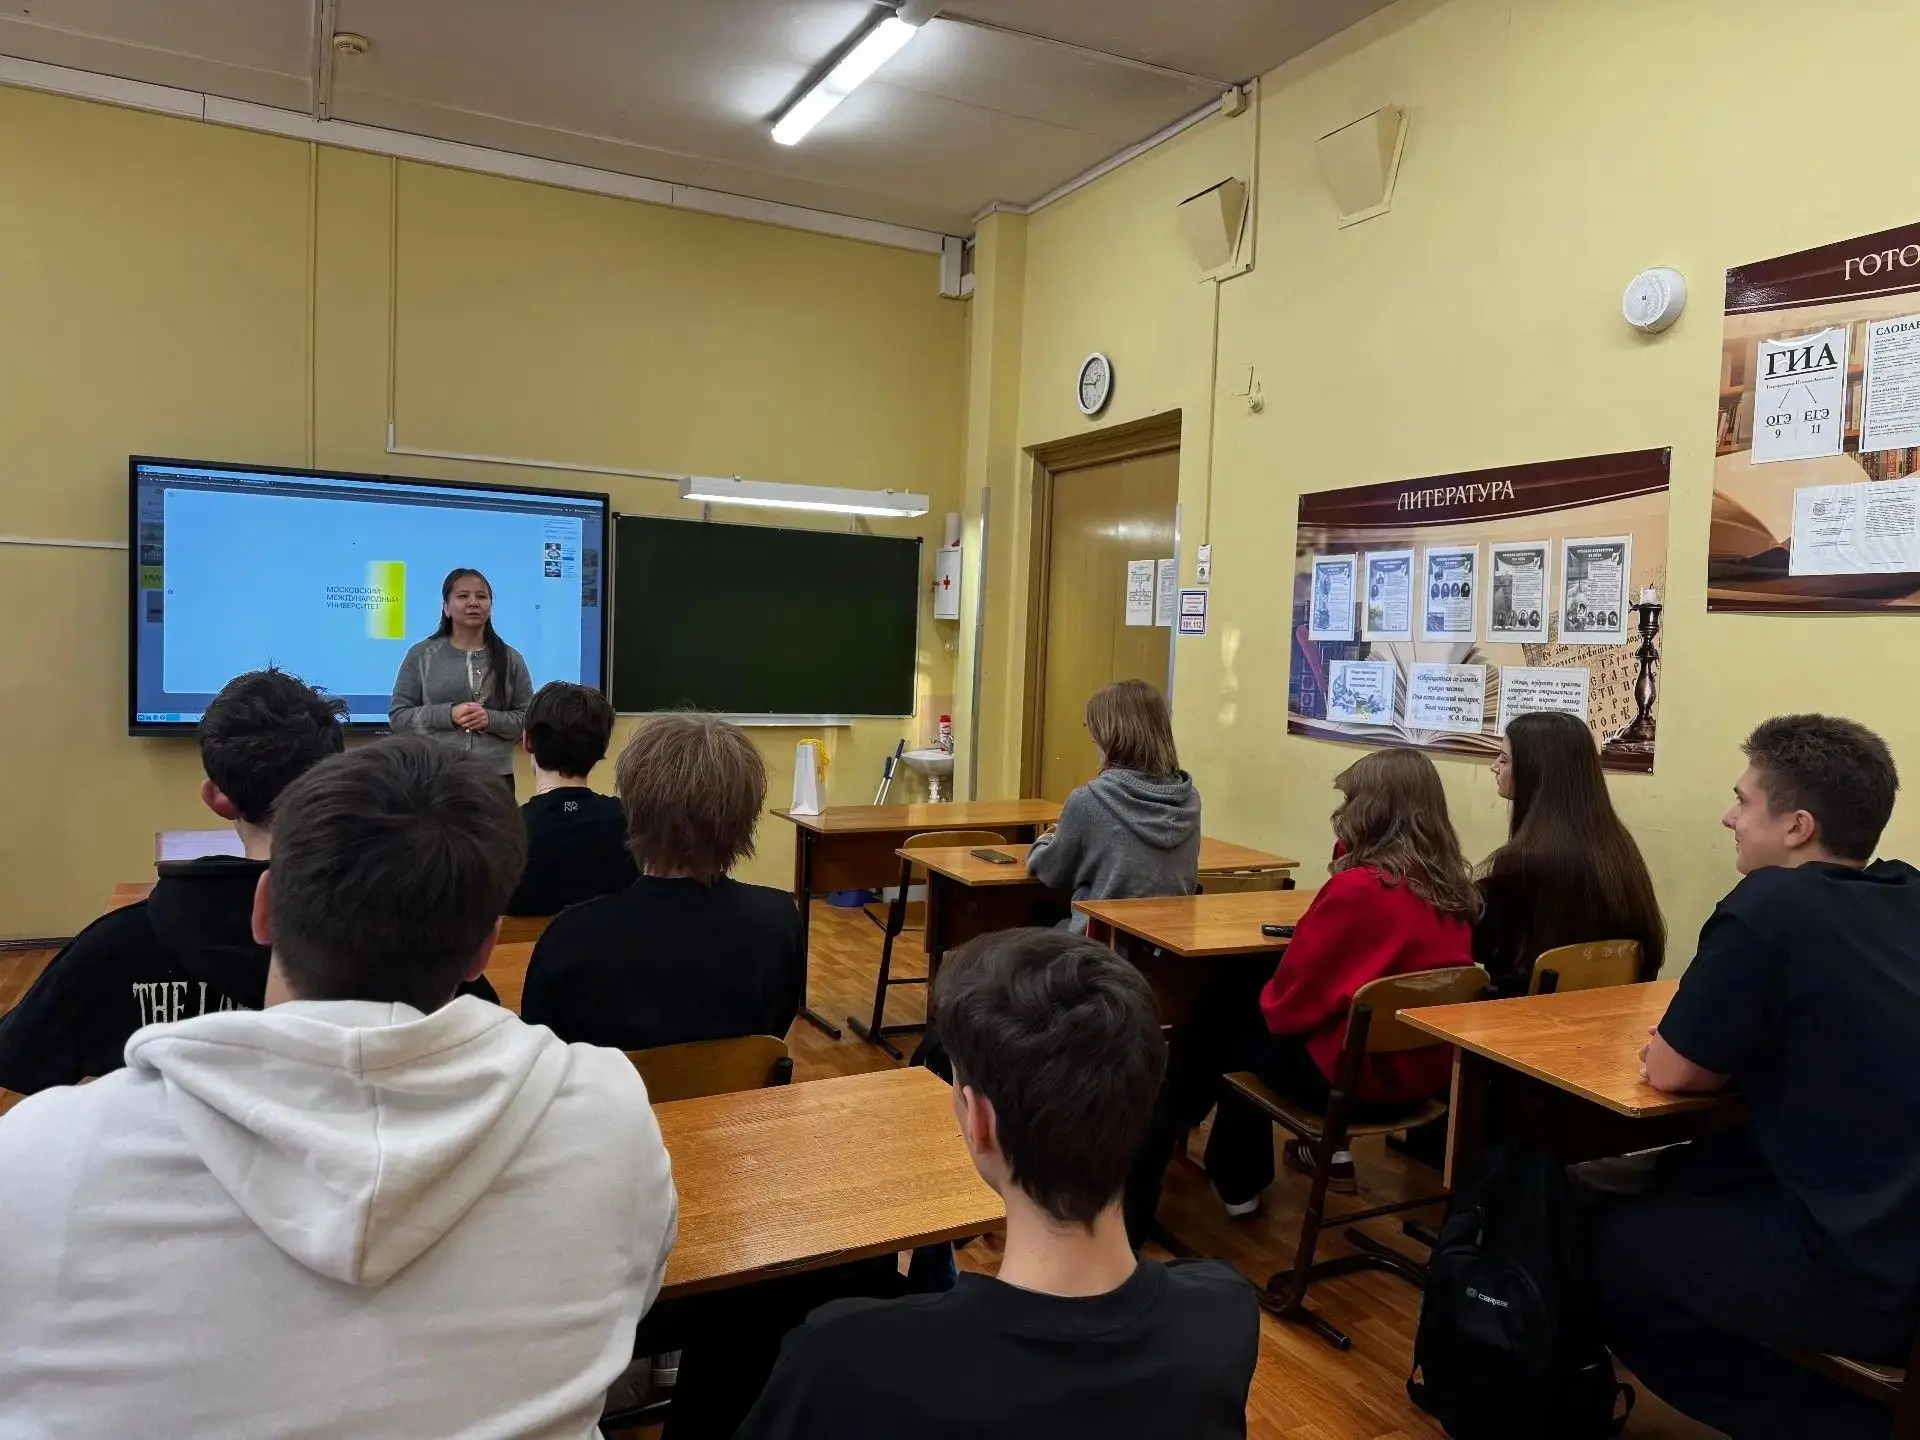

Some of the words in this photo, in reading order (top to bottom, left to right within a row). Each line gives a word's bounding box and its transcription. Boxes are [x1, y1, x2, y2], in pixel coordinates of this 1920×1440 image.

[1766, 342, 1838, 376] ГИА
[1766, 413, 1792, 427] ОГЭ
[1804, 408, 1830, 421] ЕГЭ
[1775, 428, 1782, 439] 9
[1811, 423, 1821, 434] 11
[1397, 480, 1515, 511] ЛИТЕРАТУРА
[326, 585, 381, 594] МОСКОВСКИЙ
[326, 602, 380, 610] УНИВЕРСИТЕТ
